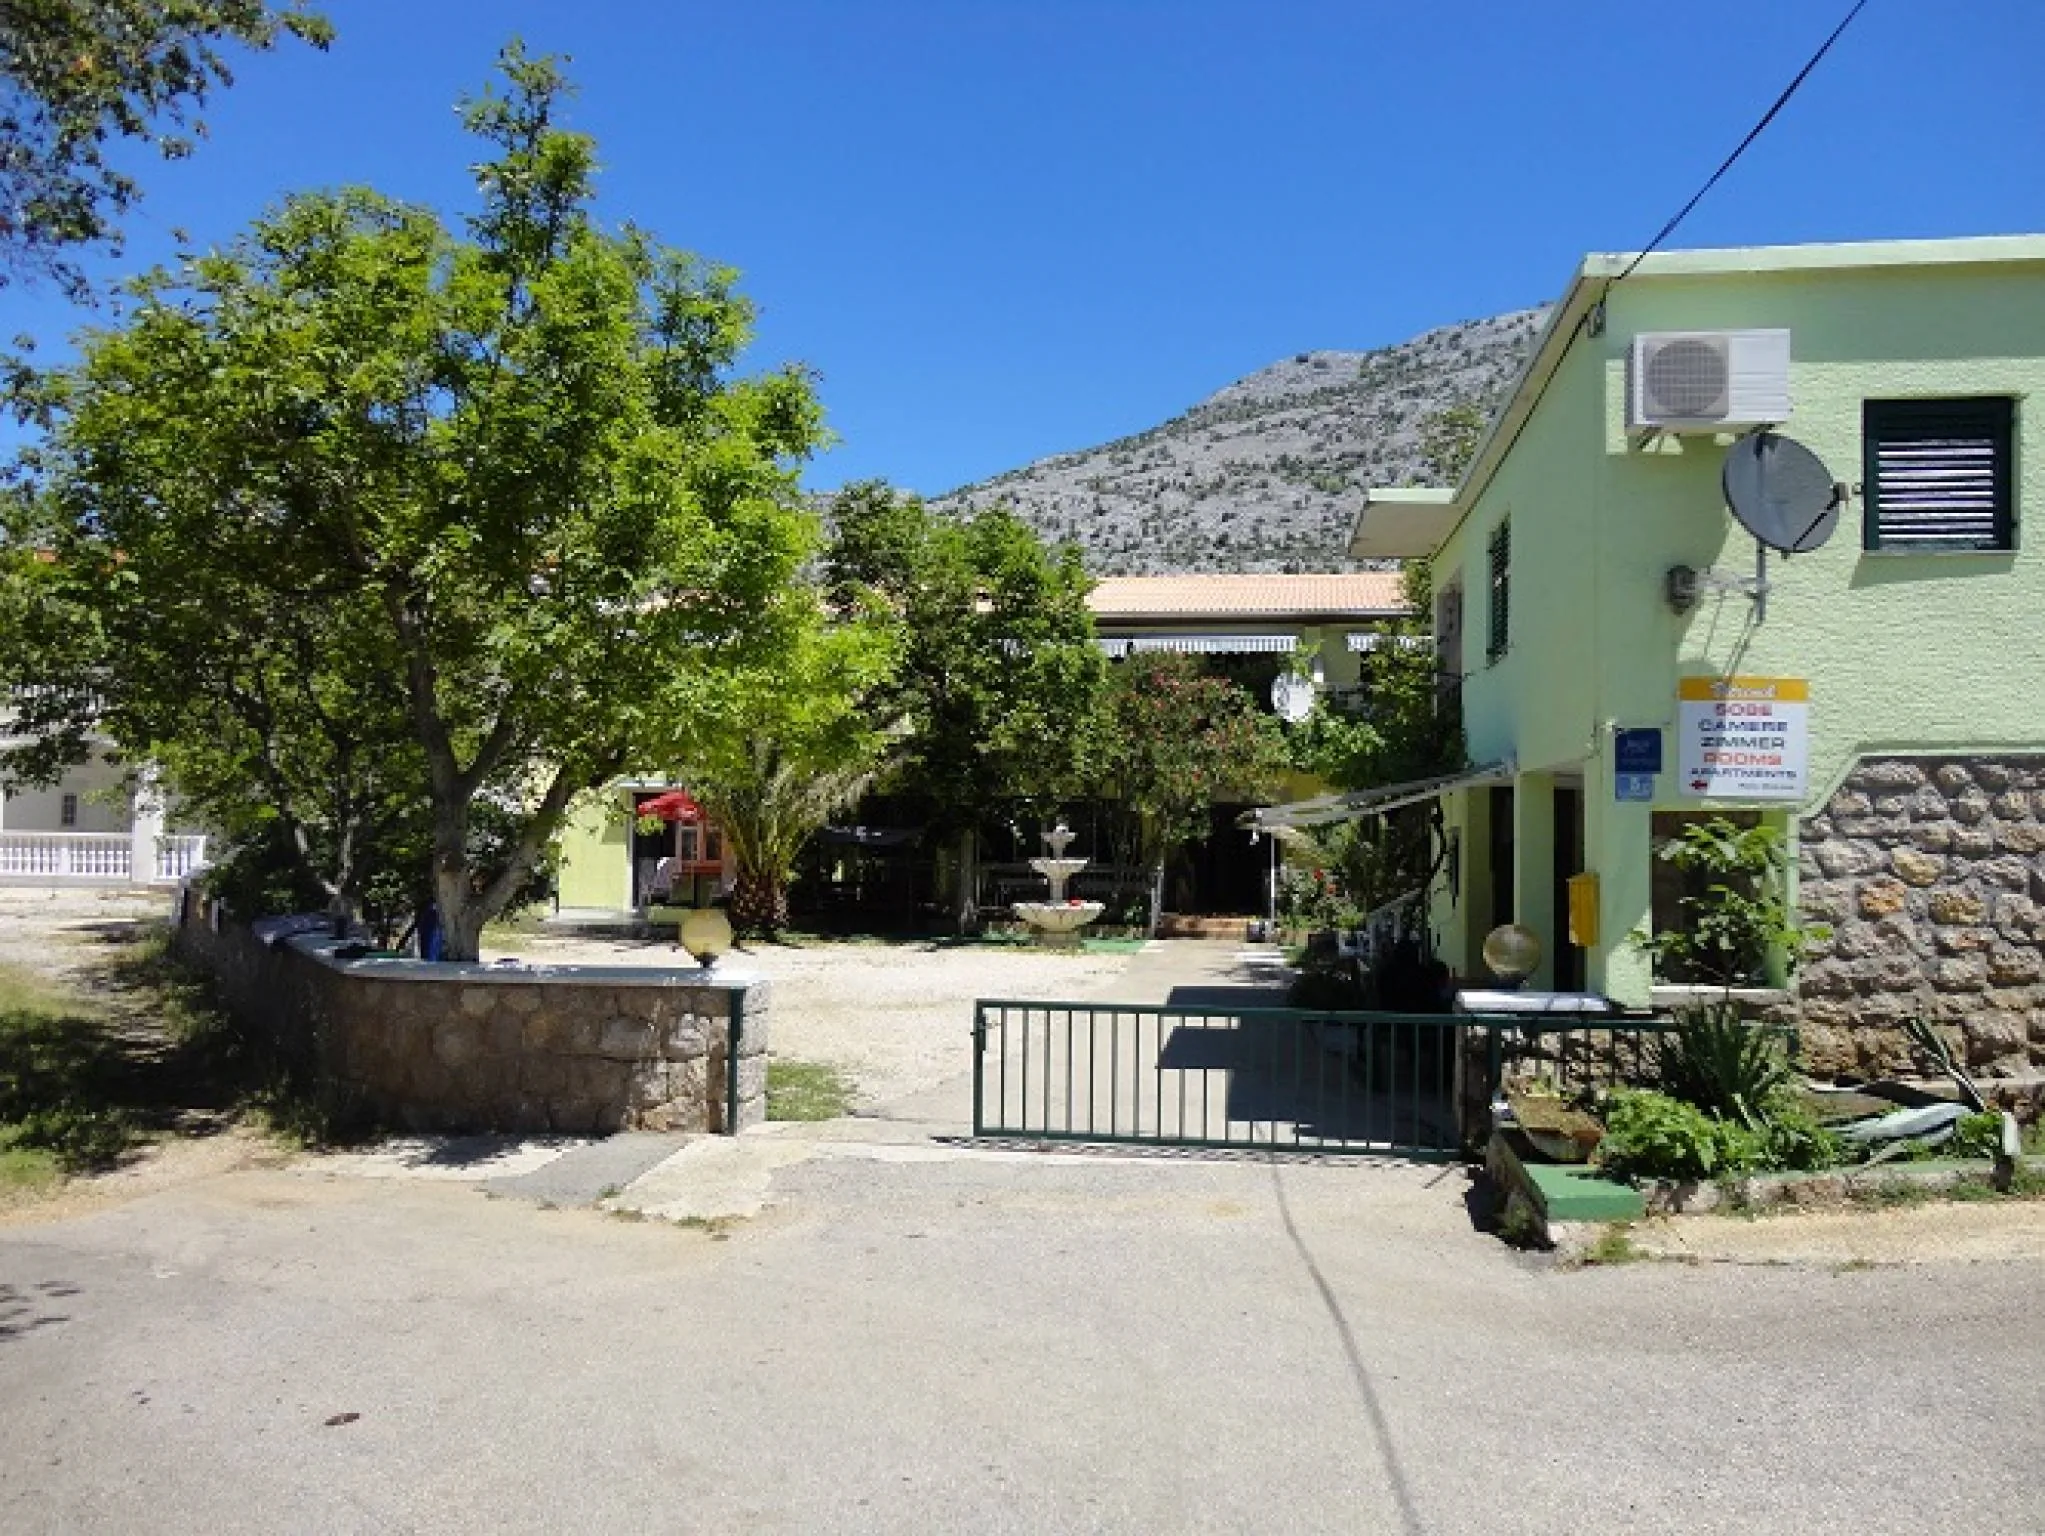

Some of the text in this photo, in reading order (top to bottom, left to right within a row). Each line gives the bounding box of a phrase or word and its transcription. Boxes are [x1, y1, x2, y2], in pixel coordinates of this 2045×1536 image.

[1698, 719, 1788, 732] CAMERE
[1700, 736, 1785, 748] ZIMMER
[1703, 752, 1782, 765] ROOMS
[1690, 767, 1797, 779] APARTMENTS
